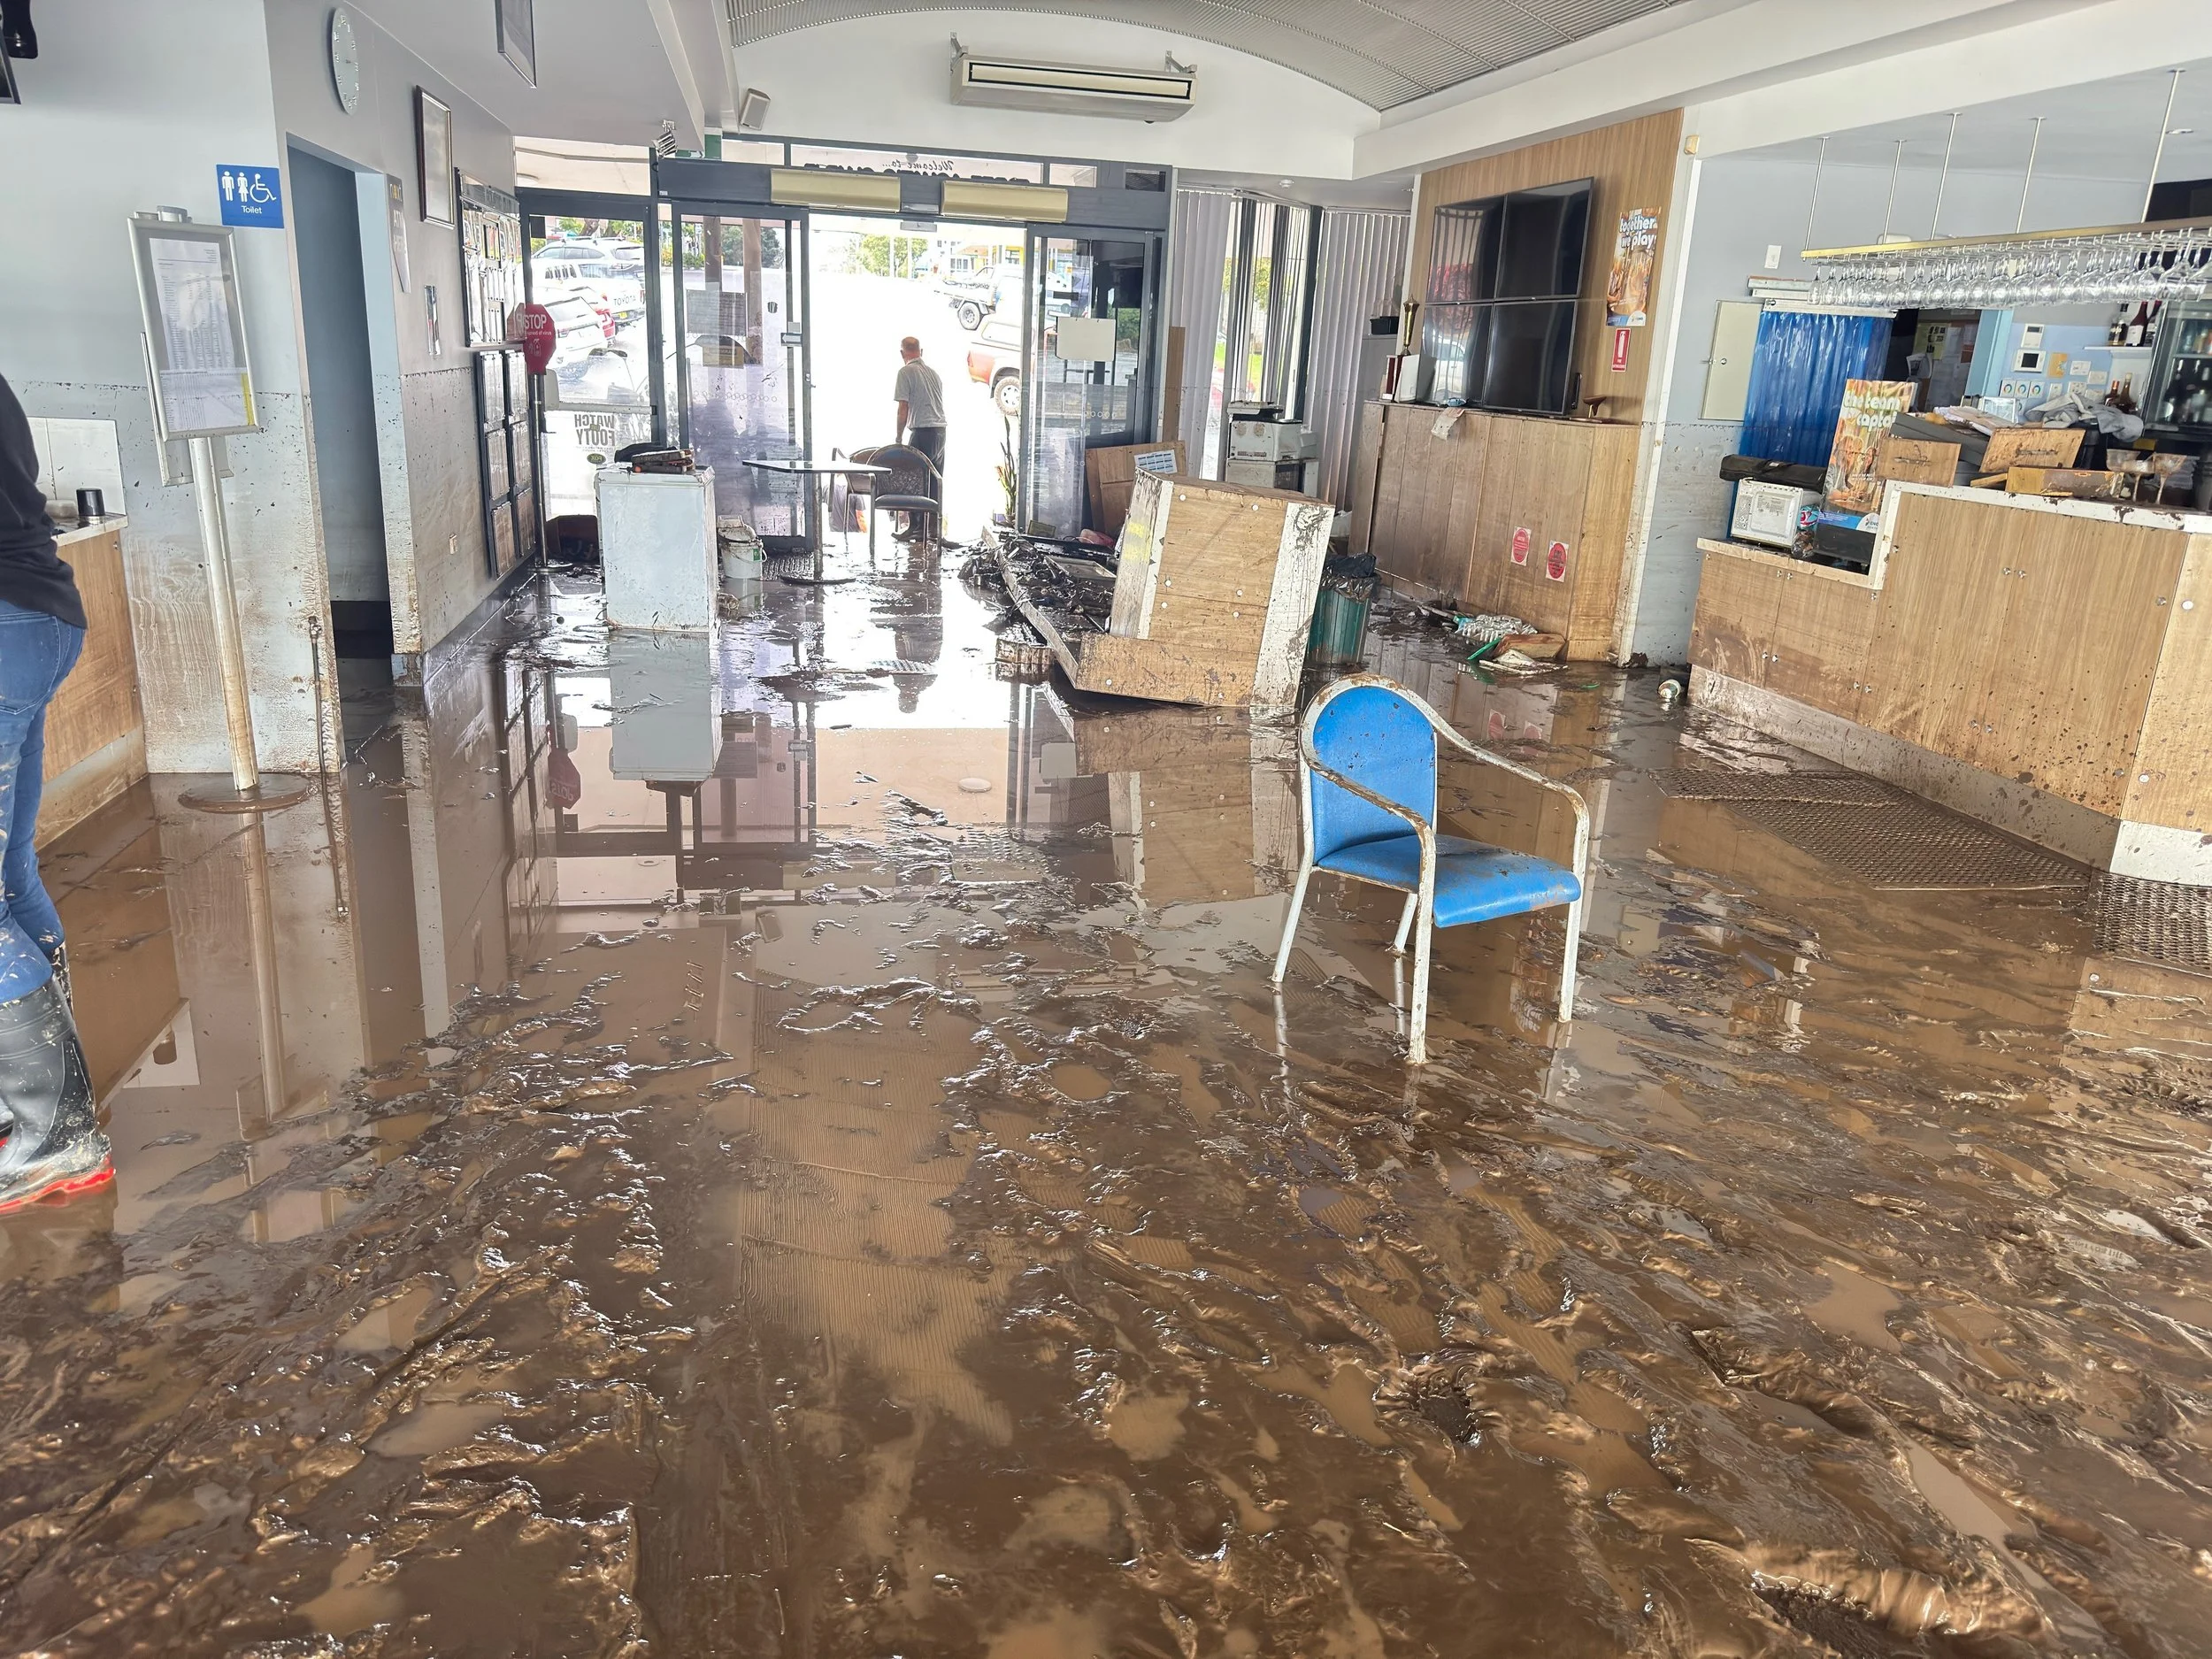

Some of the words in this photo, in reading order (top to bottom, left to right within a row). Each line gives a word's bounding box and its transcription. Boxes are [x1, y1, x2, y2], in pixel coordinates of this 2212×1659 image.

[241, 204, 263, 214] Toilet
[1619, 216, 1655, 235] together
[613, 295, 636, 306] TOYOTA
[524, 314, 547, 329] STOP
[1844, 390, 1863, 408] the
[1865, 390, 1901, 411] team
[1856, 411, 1897, 433] captai
